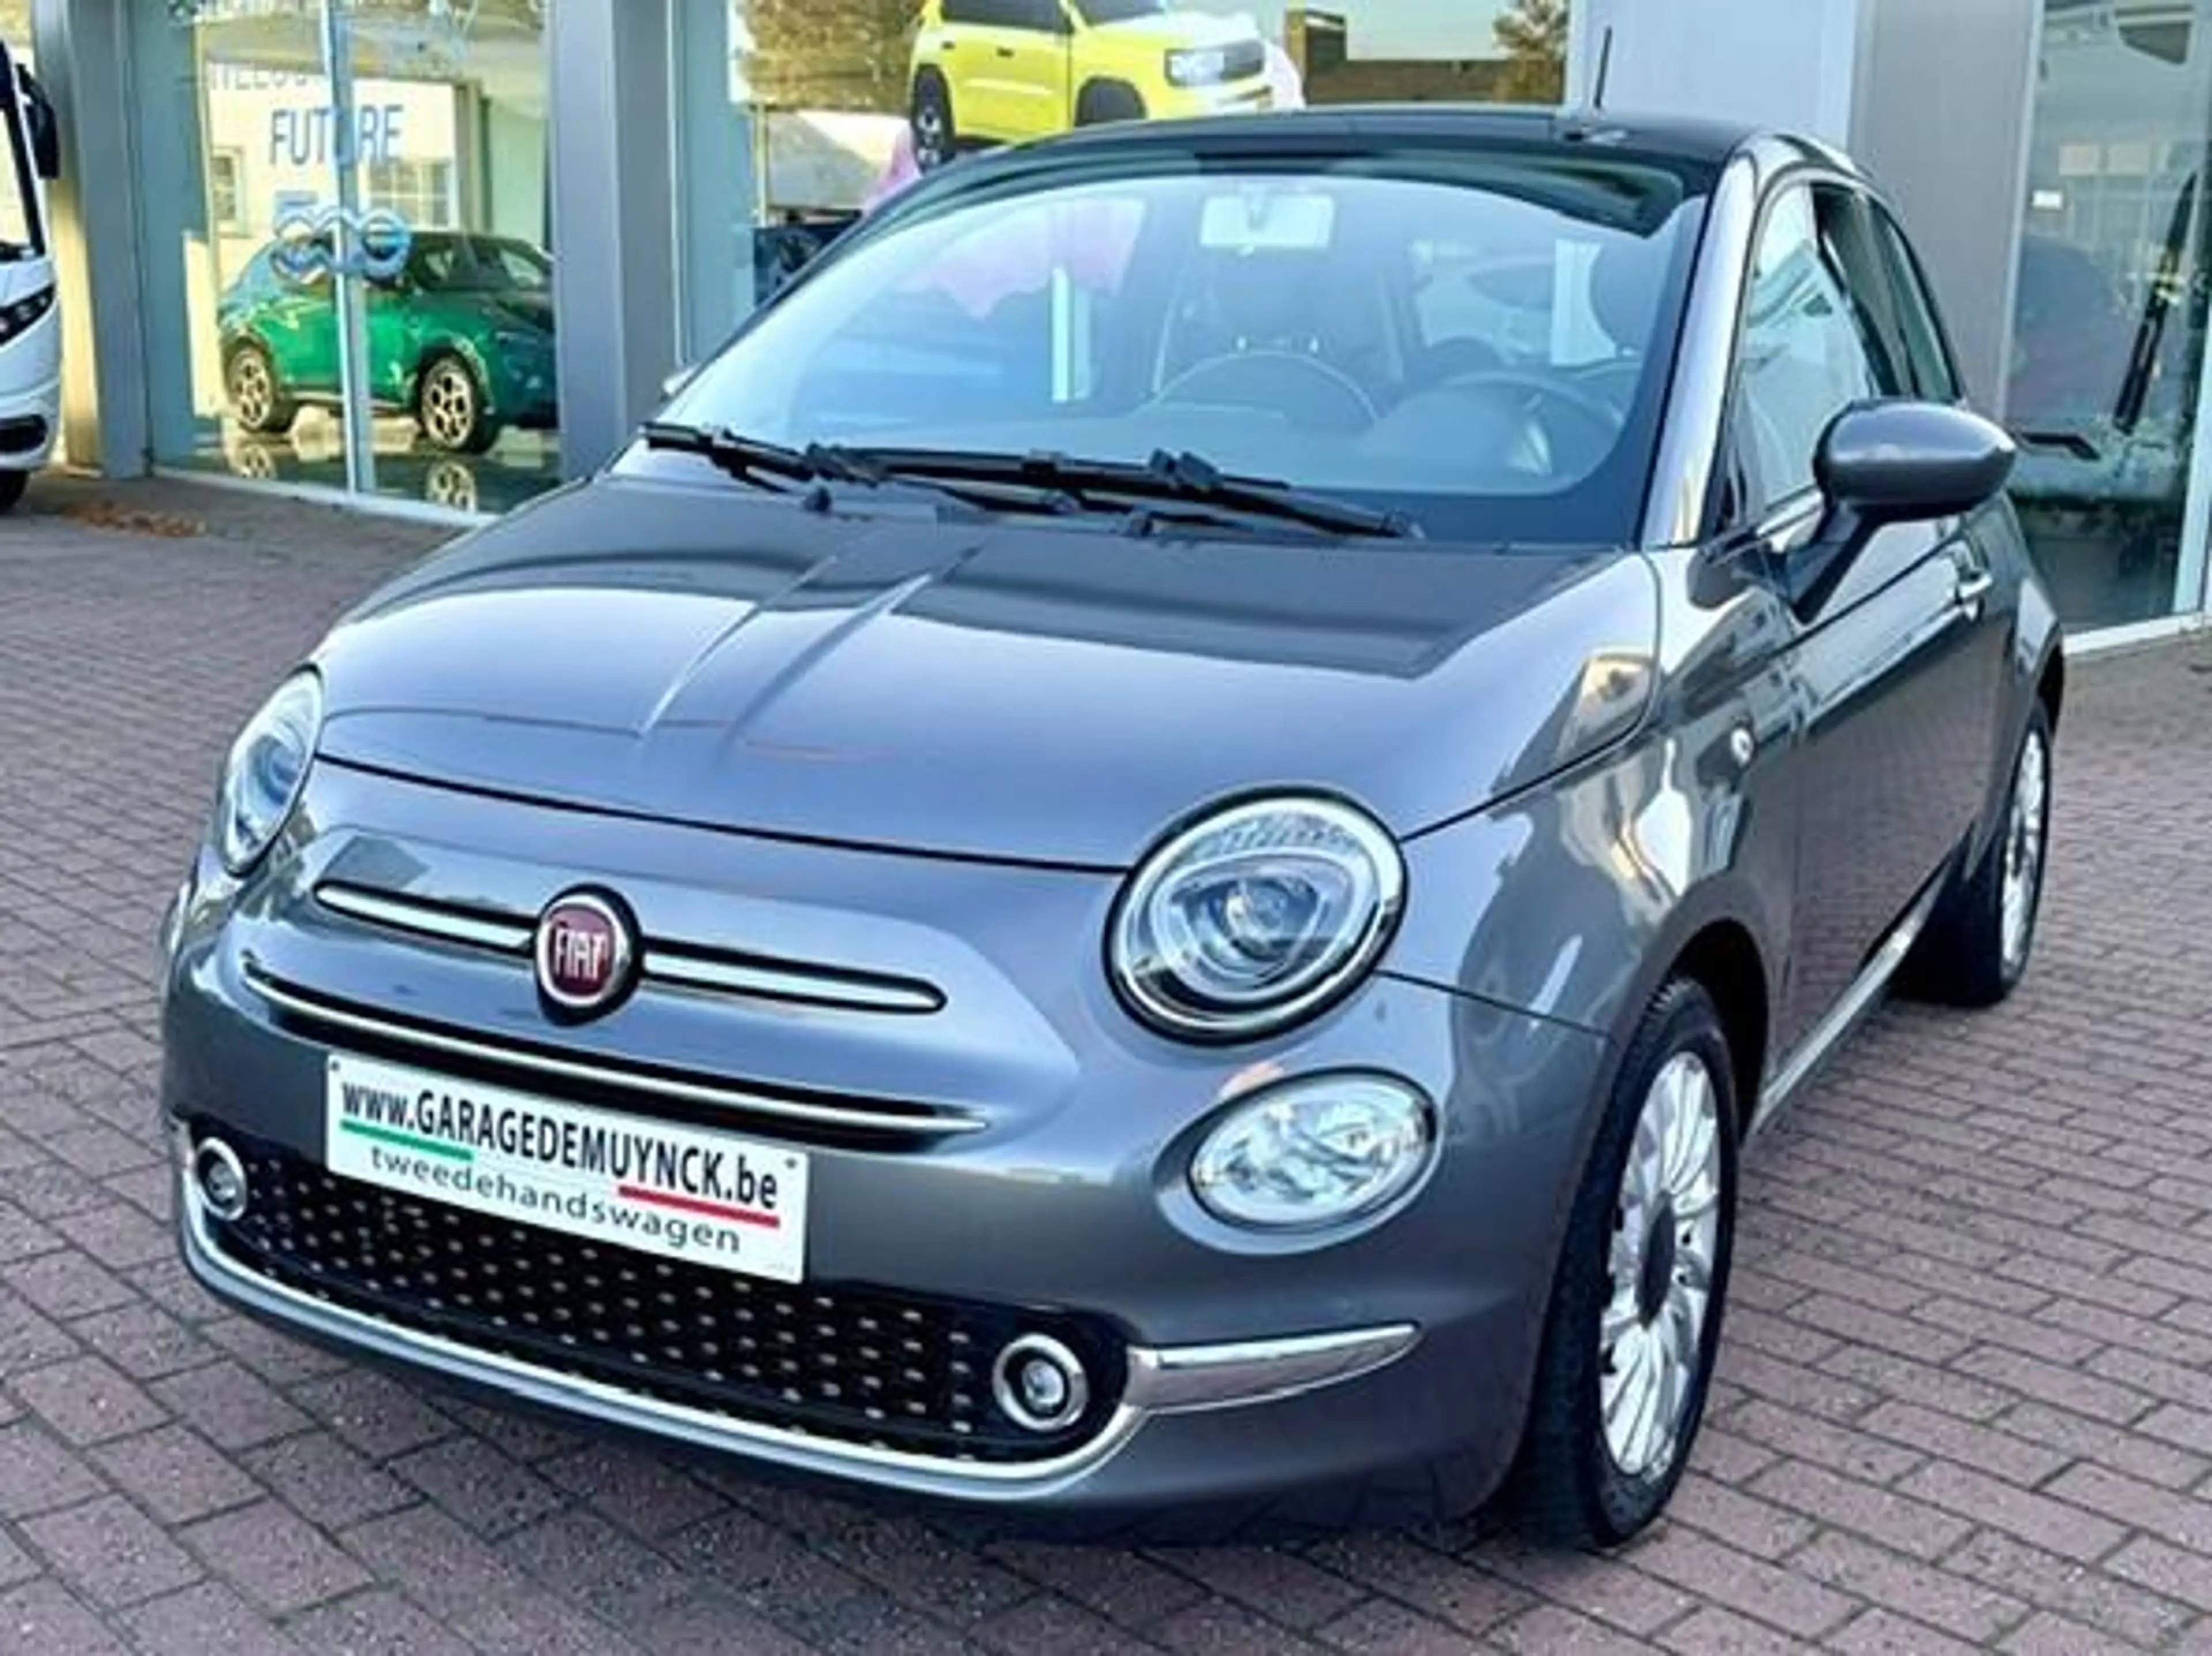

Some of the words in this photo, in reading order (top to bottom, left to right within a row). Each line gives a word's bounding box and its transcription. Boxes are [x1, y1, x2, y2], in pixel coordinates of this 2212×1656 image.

[554, 927, 609, 981] FIAT
[341, 1081, 778, 1208] www.GARAGEDEMUYNCK.be
[370, 1146, 740, 1253] tweedehandswagen
